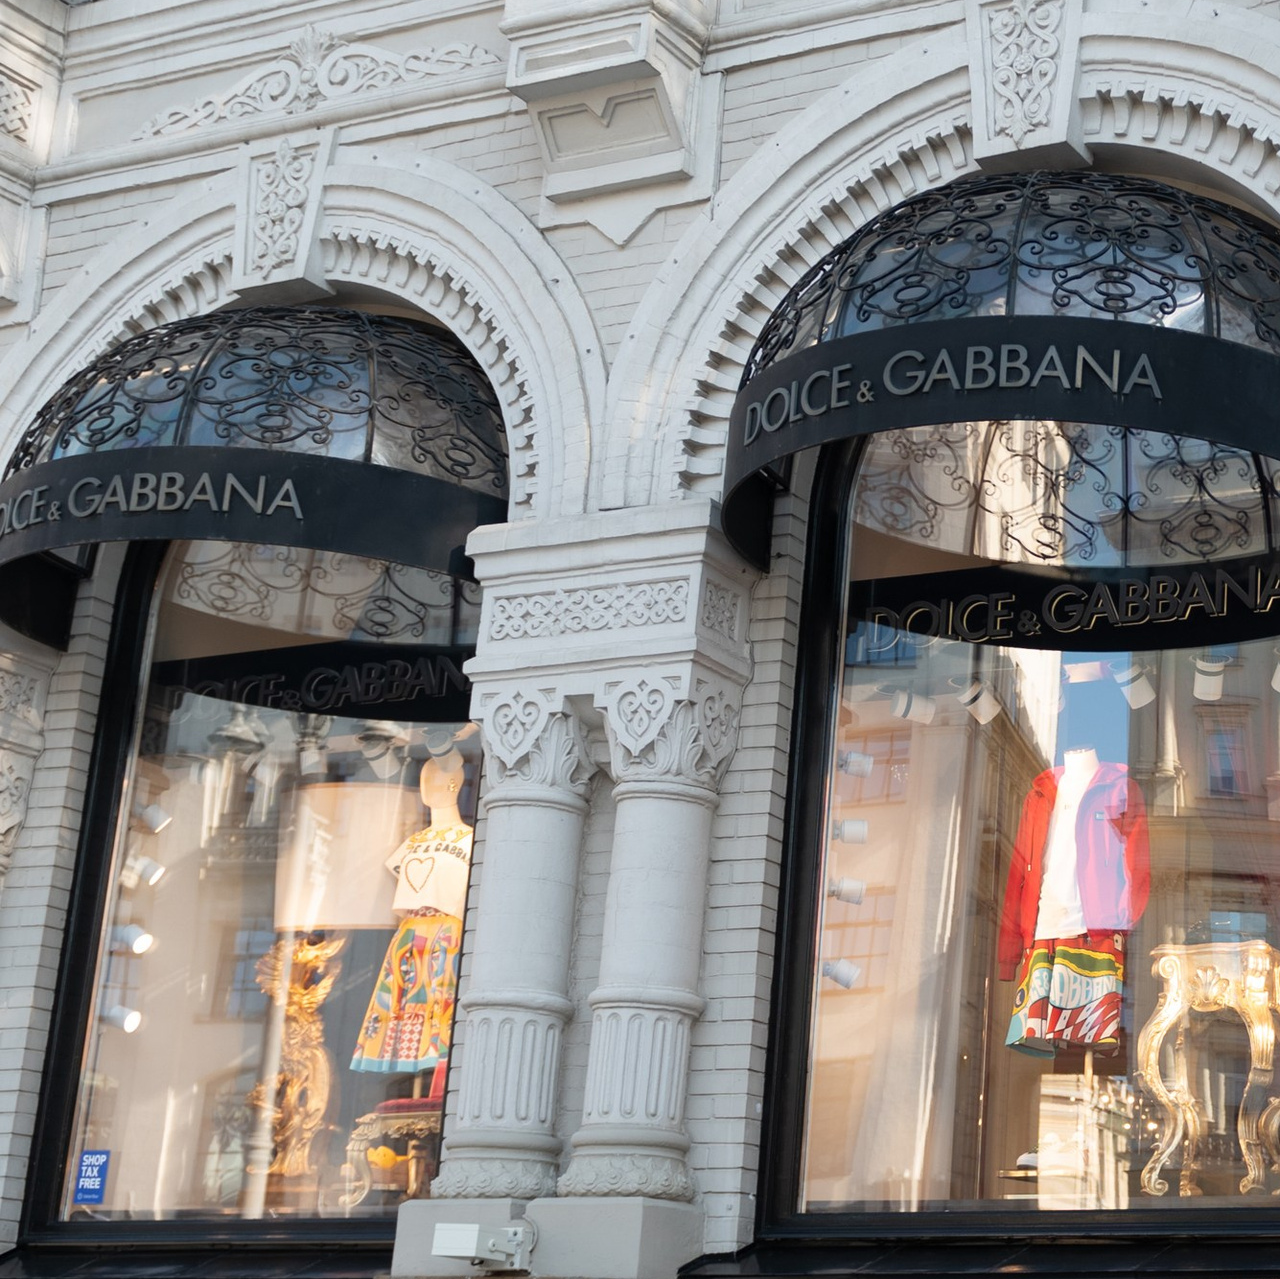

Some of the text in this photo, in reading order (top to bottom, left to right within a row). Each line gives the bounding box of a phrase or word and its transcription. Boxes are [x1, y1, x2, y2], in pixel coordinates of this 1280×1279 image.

[743, 343, 1163, 448] DOLCE & GABBANA
[47, 500, 62, 521] &
[67, 471, 304, 520] GABBANA
[866, 592, 1016, 652] DOLCE
[1017, 608, 1042, 636] &
[300, 653, 472, 709] GABBAN
[79, 1178, 101, 1189] FREE
[81, 1166, 99, 1177] TAX
[82, 1154, 107, 1166] SHOP
